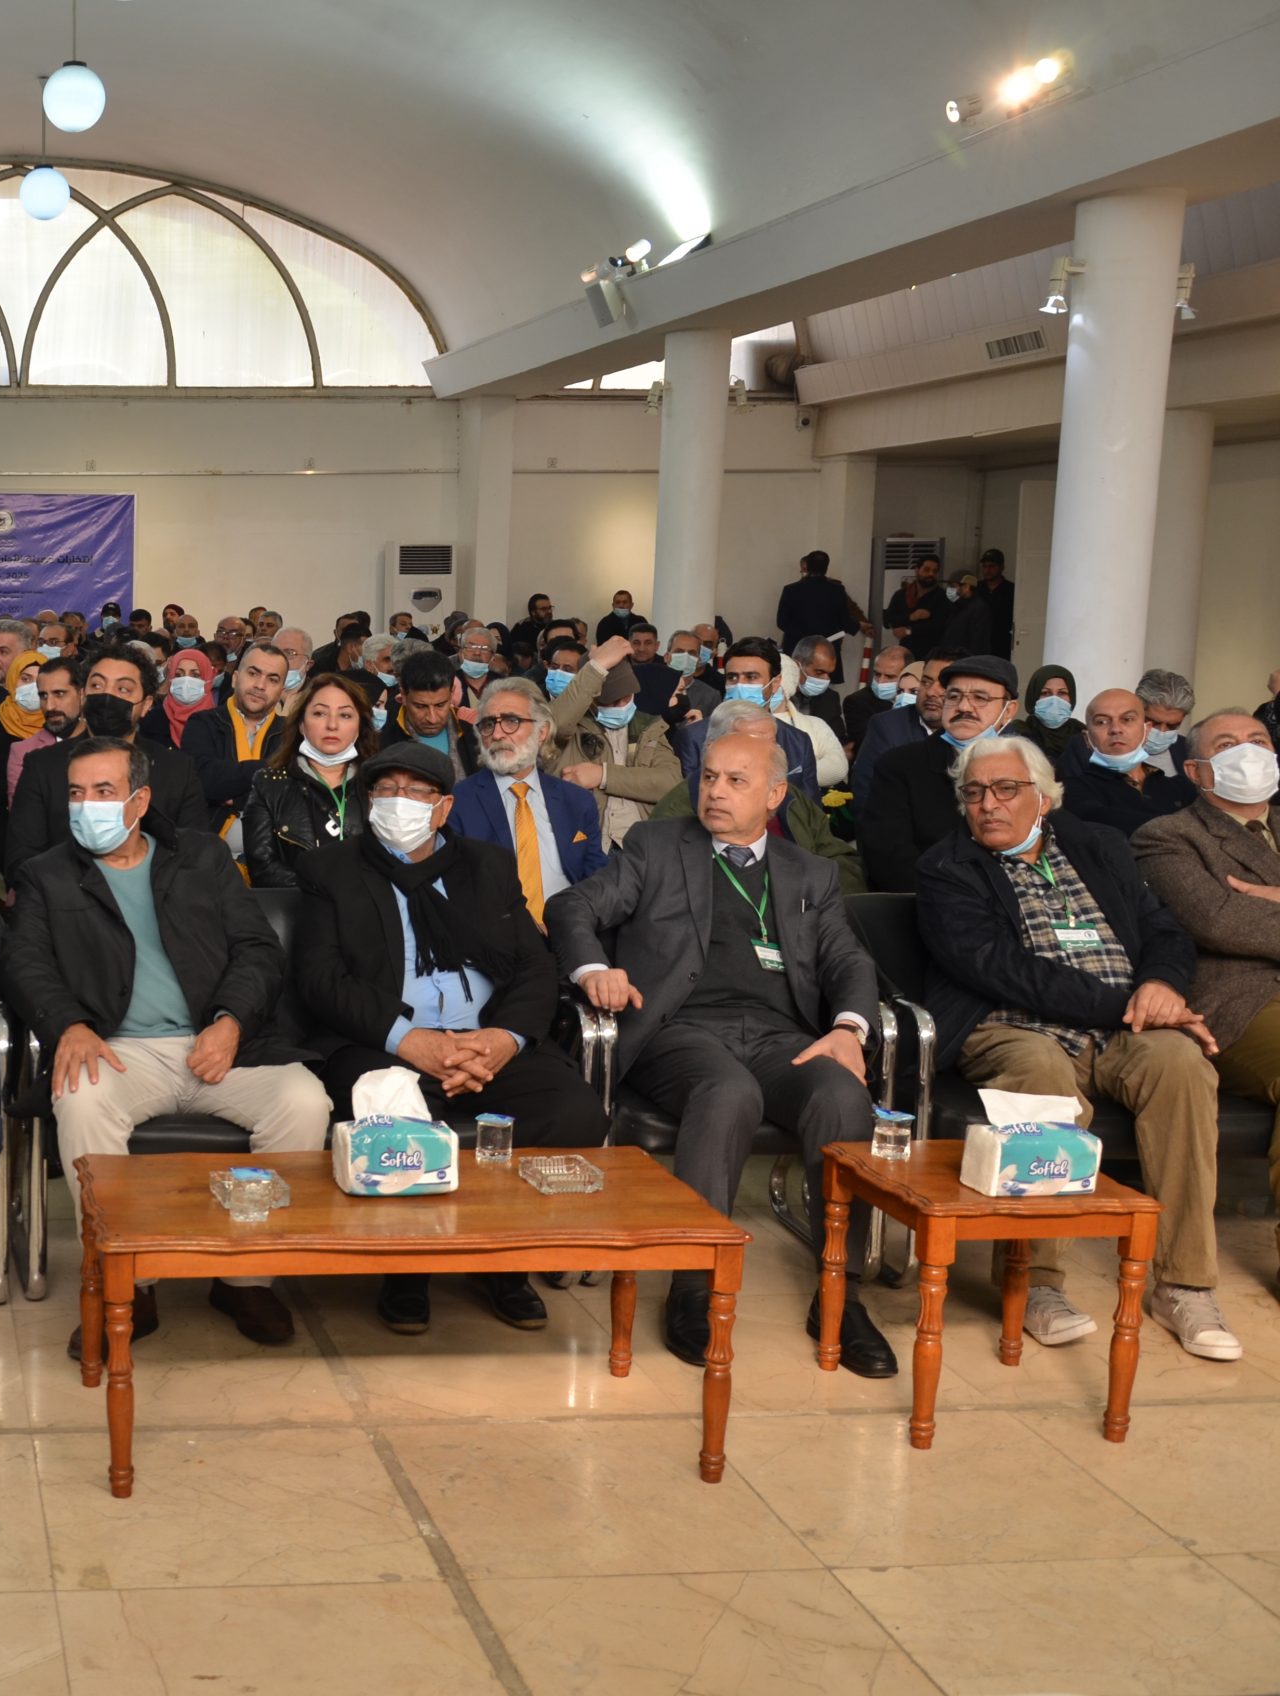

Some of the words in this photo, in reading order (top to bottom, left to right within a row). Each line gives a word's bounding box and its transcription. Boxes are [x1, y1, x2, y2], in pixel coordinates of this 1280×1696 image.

[1000, 1122, 1040, 1134] Softel
[380, 1151, 422, 1167] Softel
[1029, 1160, 1068, 1176] Softel
